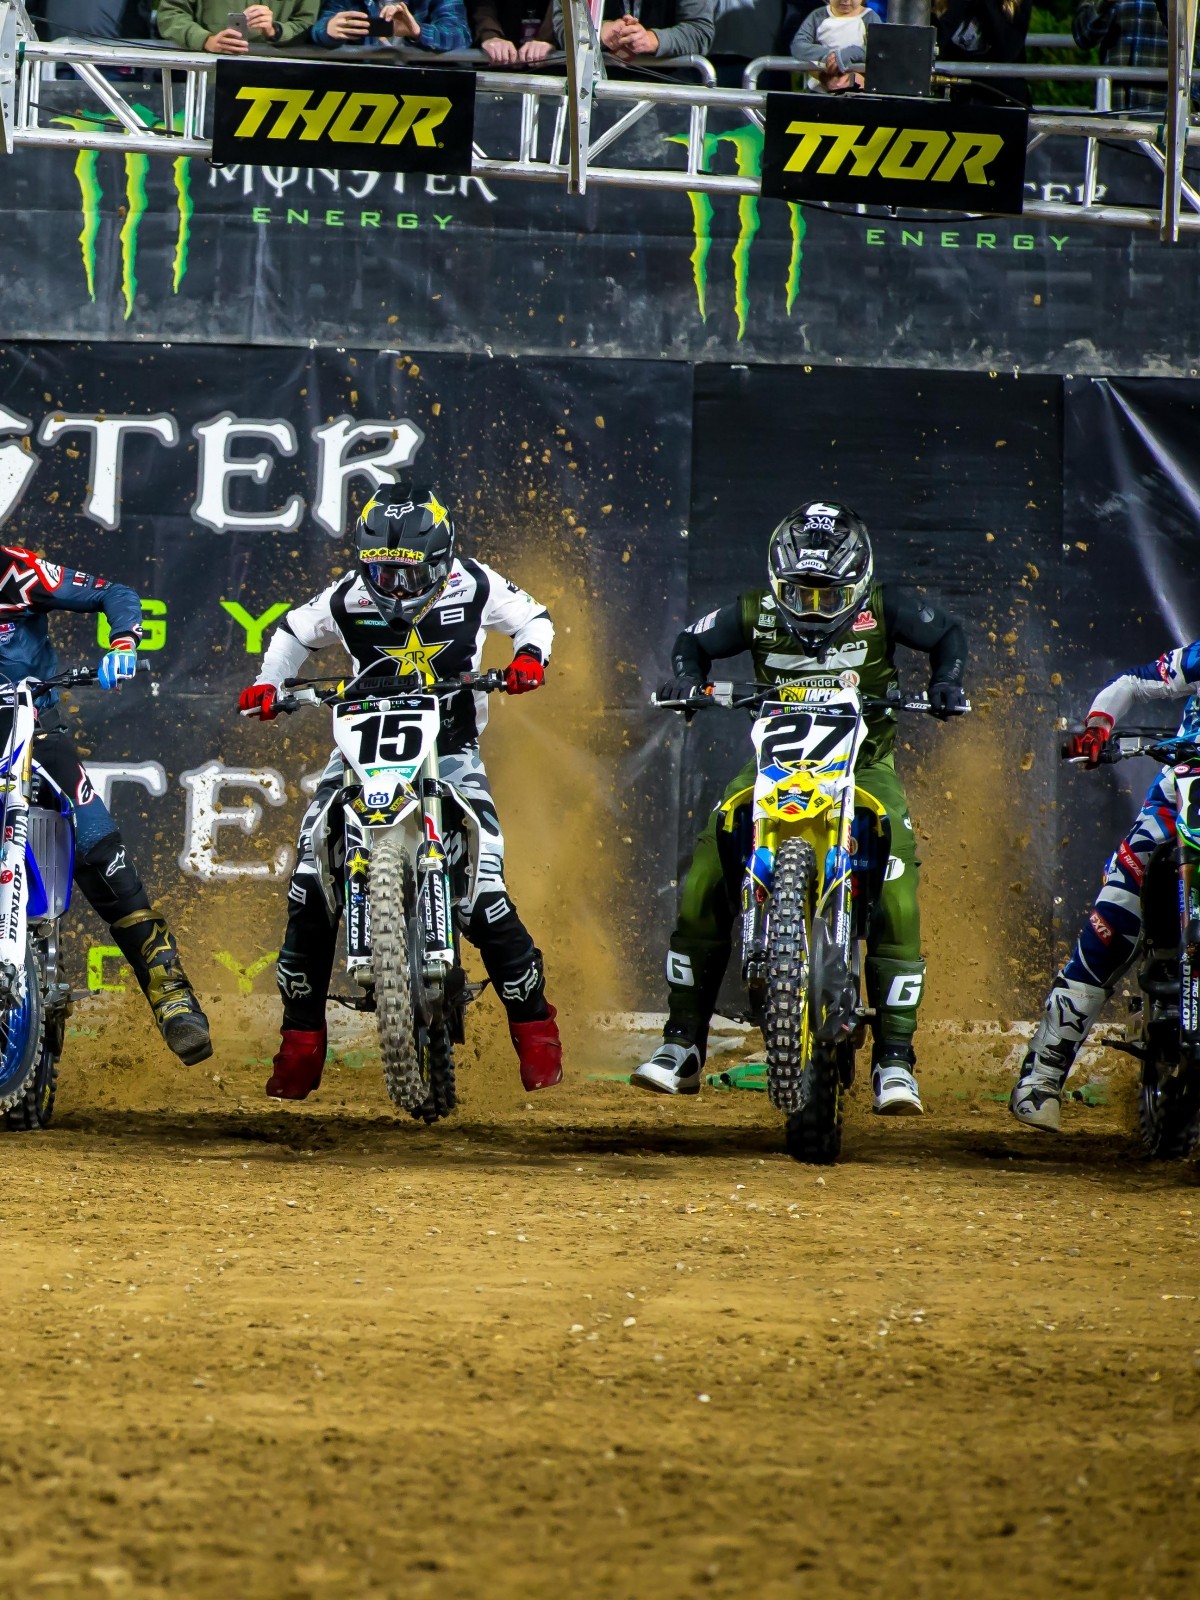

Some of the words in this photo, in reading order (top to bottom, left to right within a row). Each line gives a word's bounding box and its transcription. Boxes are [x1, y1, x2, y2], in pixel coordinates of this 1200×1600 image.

[234, 87, 452, 147] THOR
[784, 122, 1005, 186] THOR
[253, 207, 454, 230] ENERGY
[866, 229, 1070, 251] ENERGY
[360, 547, 425, 562] ROCKSTAR
[801, 560, 823, 568] SHOEI
[790, 705, 827, 713] MONSTER
[351, 713, 423, 764] 15
[760, 714, 858, 766] 27
[8, 863, 24, 943] DUNLOP
[433, 873, 447, 948] DUNLOP
[1089, 912, 1112, 939] FXR
[1182, 963, 1191, 1031] DUNLOP
